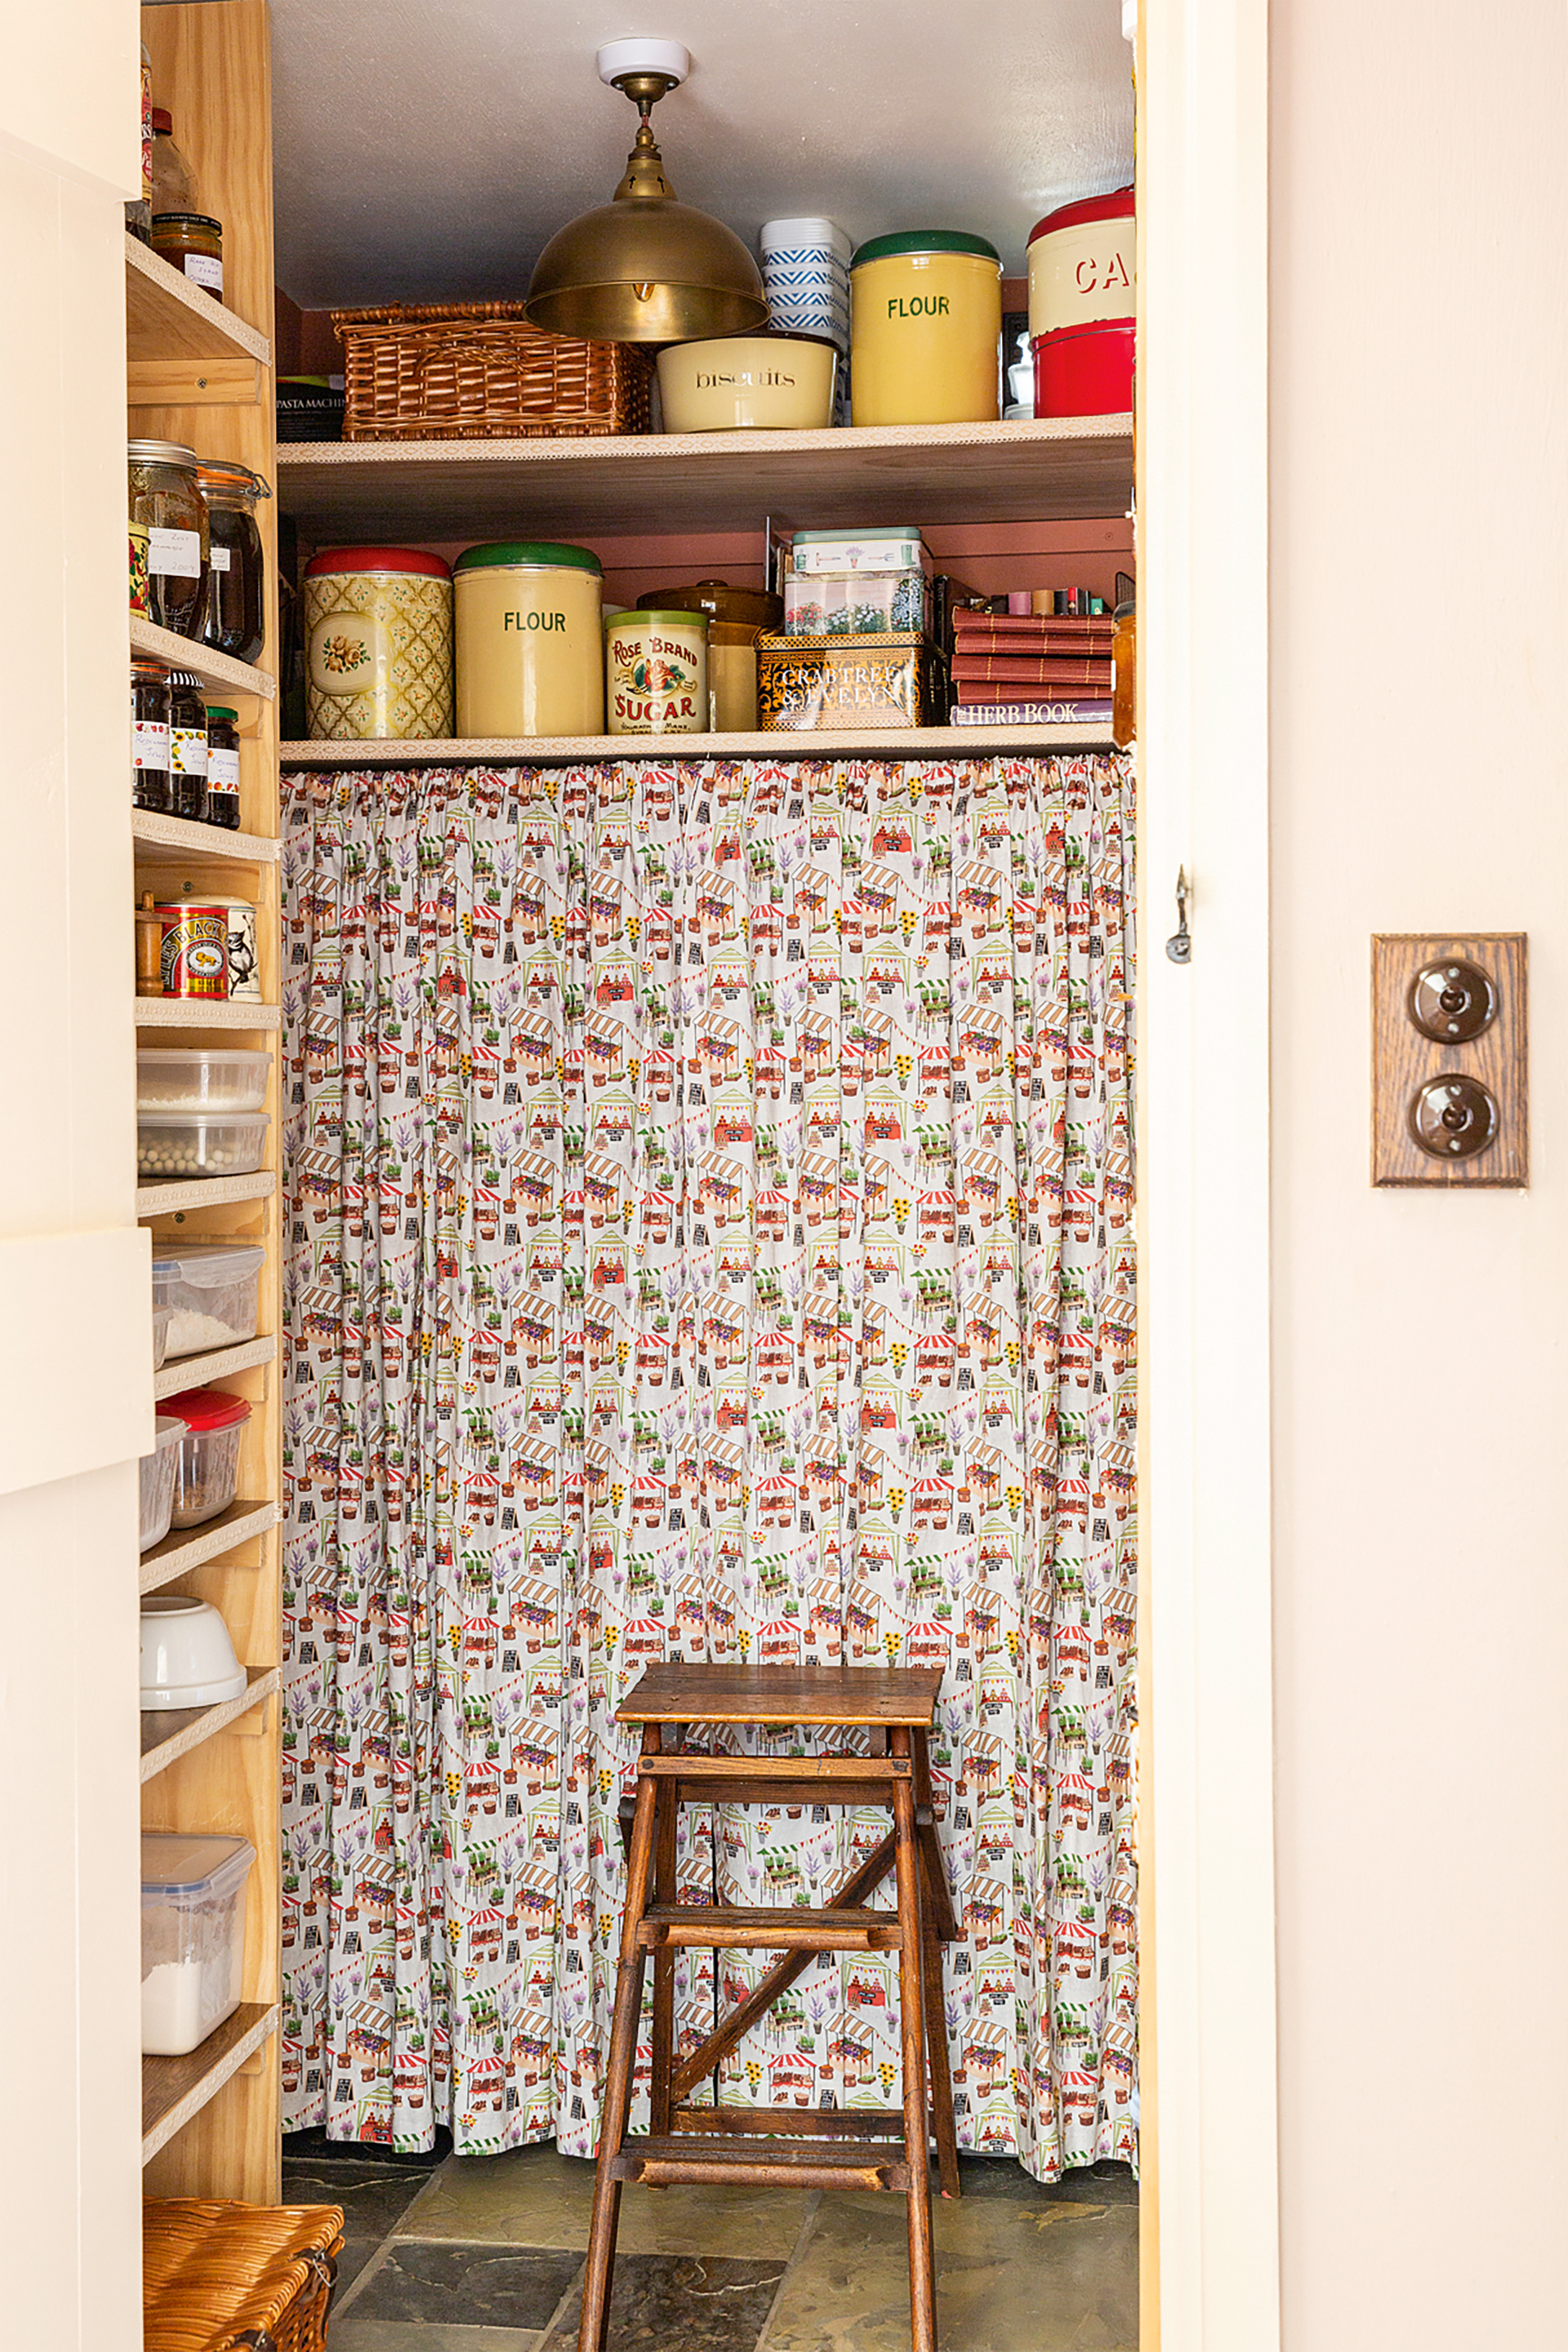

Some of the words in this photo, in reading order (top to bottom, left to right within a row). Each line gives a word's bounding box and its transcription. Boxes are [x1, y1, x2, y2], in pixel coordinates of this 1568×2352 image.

[888, 296, 950, 319] FLOUR
[696, 368, 795, 388] biscuits
[276, 399, 305, 409] PASTA
[504, 611, 566, 633] FLOUR
[648, 636, 697, 667] BRAND
[614, 693, 697, 721] SUGAR
[968, 705, 1021, 725] HERB
[1023, 703, 1079, 724] BOOK
[173, 920, 220, 944] BLACK
